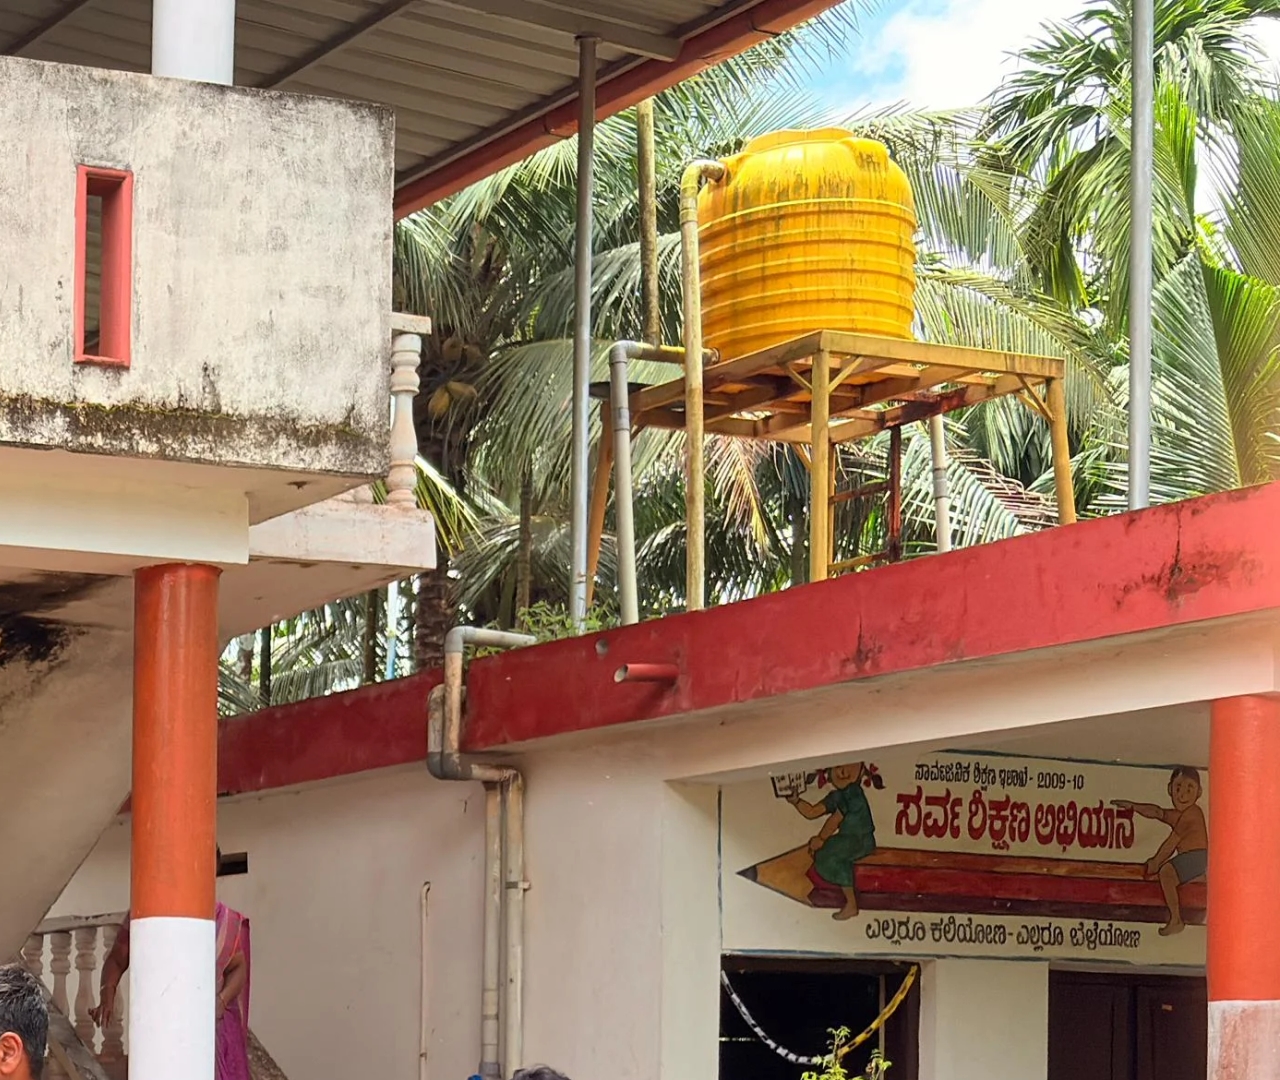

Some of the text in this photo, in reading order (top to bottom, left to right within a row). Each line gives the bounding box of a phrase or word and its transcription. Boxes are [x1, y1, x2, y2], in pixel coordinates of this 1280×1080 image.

[1037, 772, 1085, 790] 2009-10
[895, 786, 1136, 853] ಸರ್ವ ಶಿಕ್ಷಣ ಅಭಿಯಾನ
[865, 917, 925, 946] ಎಲ್ಲರೂ
